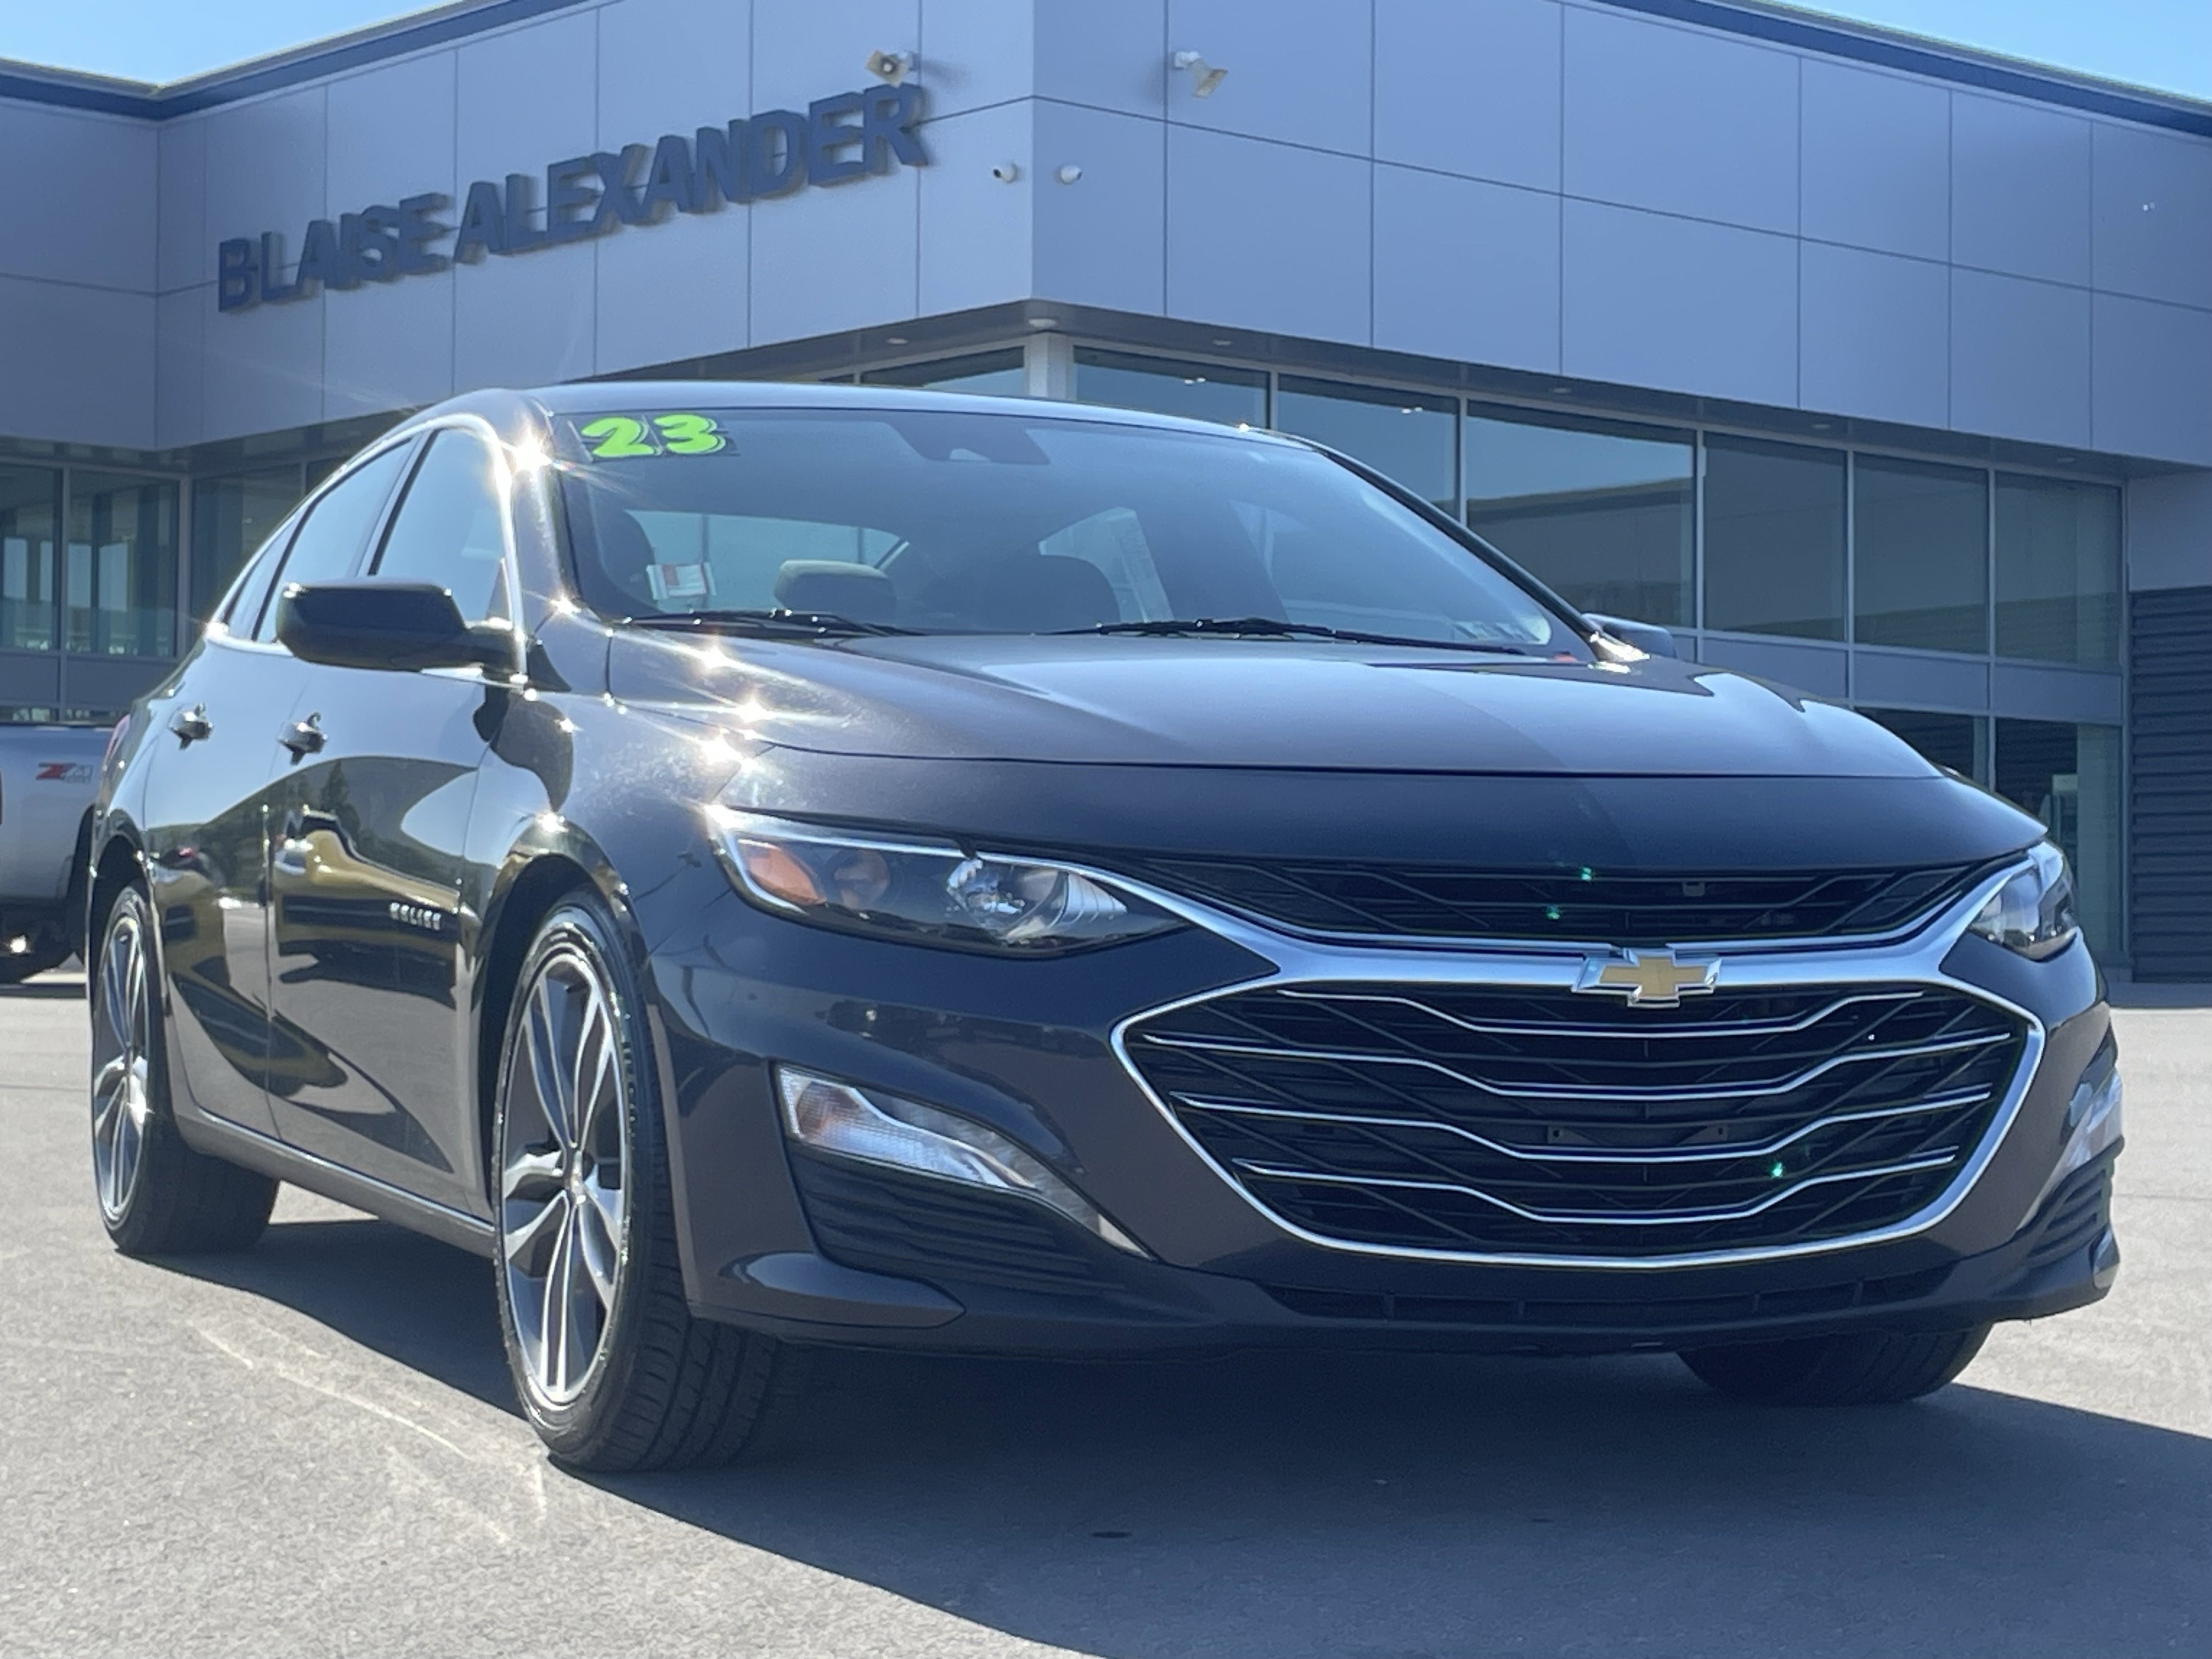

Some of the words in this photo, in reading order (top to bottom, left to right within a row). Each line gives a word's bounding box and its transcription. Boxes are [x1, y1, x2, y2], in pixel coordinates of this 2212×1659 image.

[219, 193, 454, 312] BLAISE
[454, 82, 930, 264] ALEXANDER
[580, 413, 726, 458] 23
